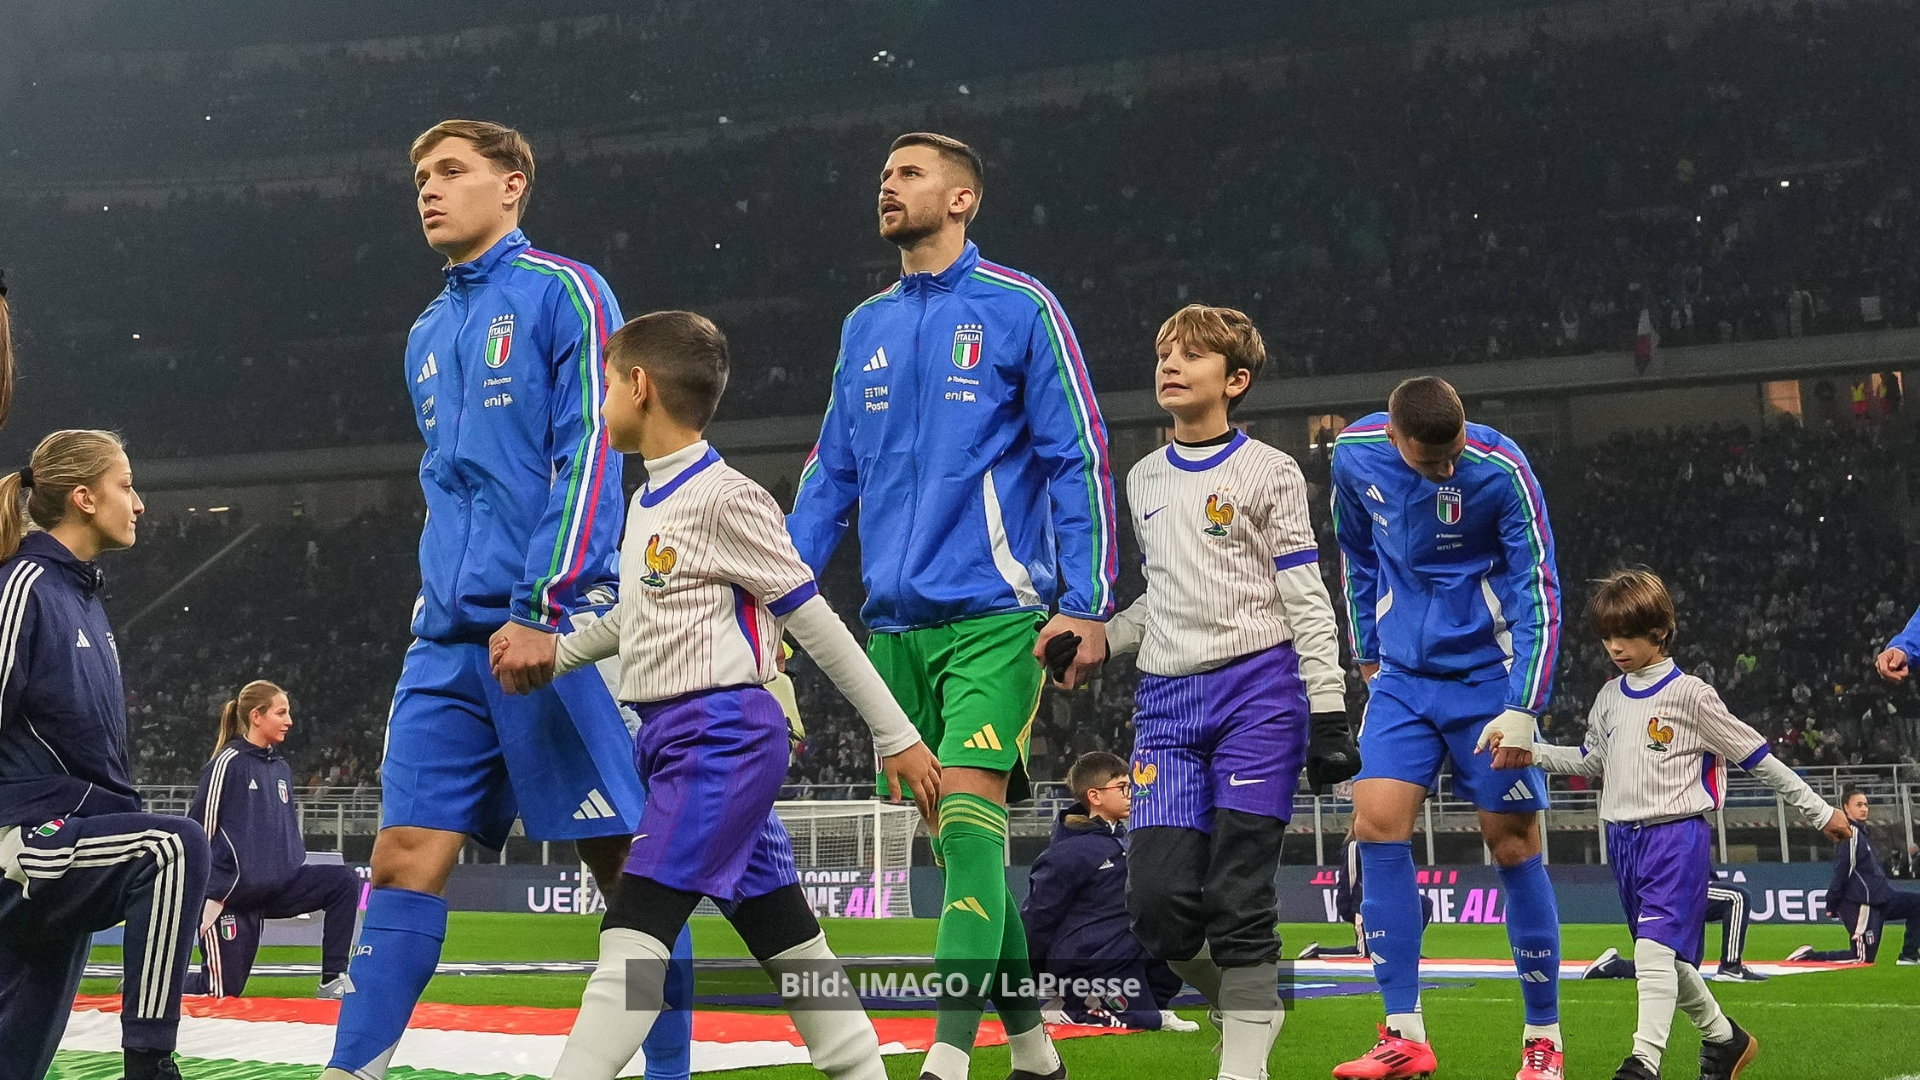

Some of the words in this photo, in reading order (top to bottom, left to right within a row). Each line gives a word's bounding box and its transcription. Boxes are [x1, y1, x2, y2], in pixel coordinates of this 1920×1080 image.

[490, 324, 511, 336] ITALIA
[957, 333, 980, 342] ITALIA
[873, 385, 888, 397] TIM
[944, 390, 962, 401] eni
[484, 394, 502, 408] eni
[865, 401, 889, 412] Poste
[1439, 494, 1459, 503] ITALIA
[527, 887, 607, 912] UEFA
[1459, 888, 1507, 923] AL
[1749, 889, 1839, 921] UEF
[1513, 946, 1551, 959] ITALIA
